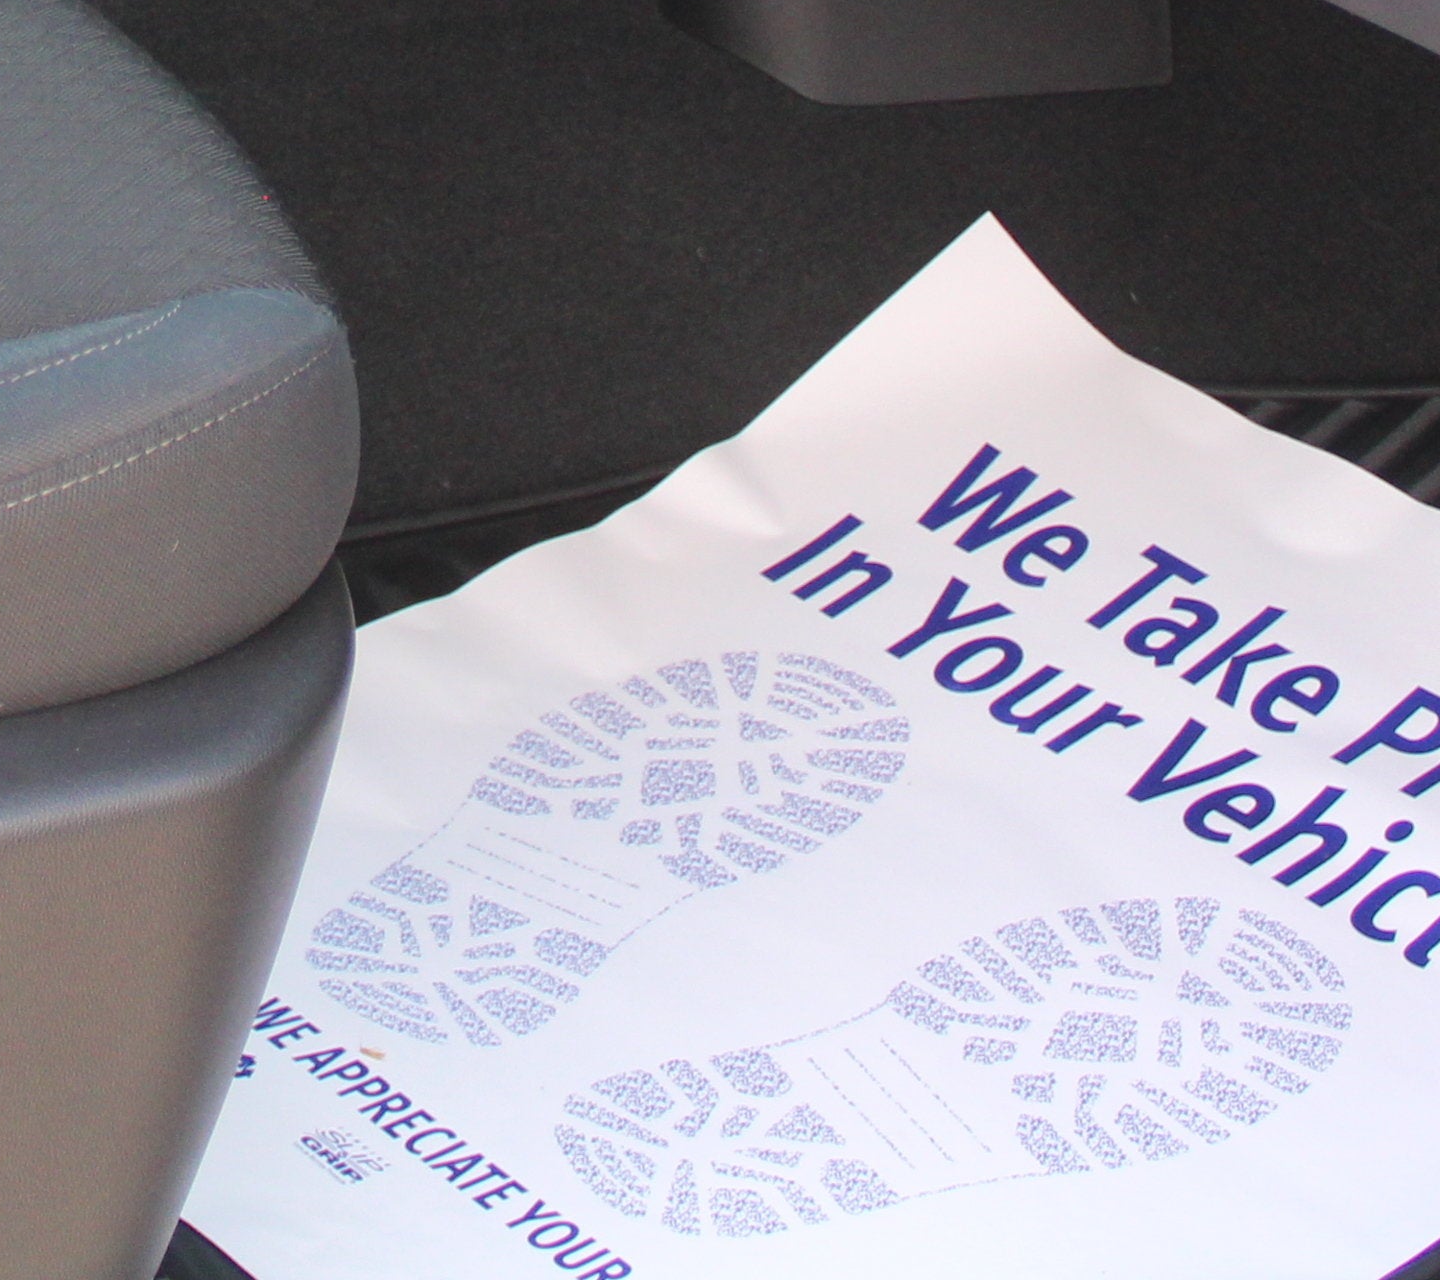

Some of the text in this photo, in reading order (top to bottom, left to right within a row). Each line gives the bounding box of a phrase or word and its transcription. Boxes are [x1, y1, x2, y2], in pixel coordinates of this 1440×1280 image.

[760, 513, 893, 619] In
[885, 576, 1144, 755] Your
[917, 442, 1090, 588] We
[1085, 543, 1341, 733] Take
[253, 996, 321, 1050] WE
[292, 1046, 529, 1211] APPRECIATE
[506, 1198, 632, 1280] YOUR
[300, 1136, 363, 1181] GRIP
